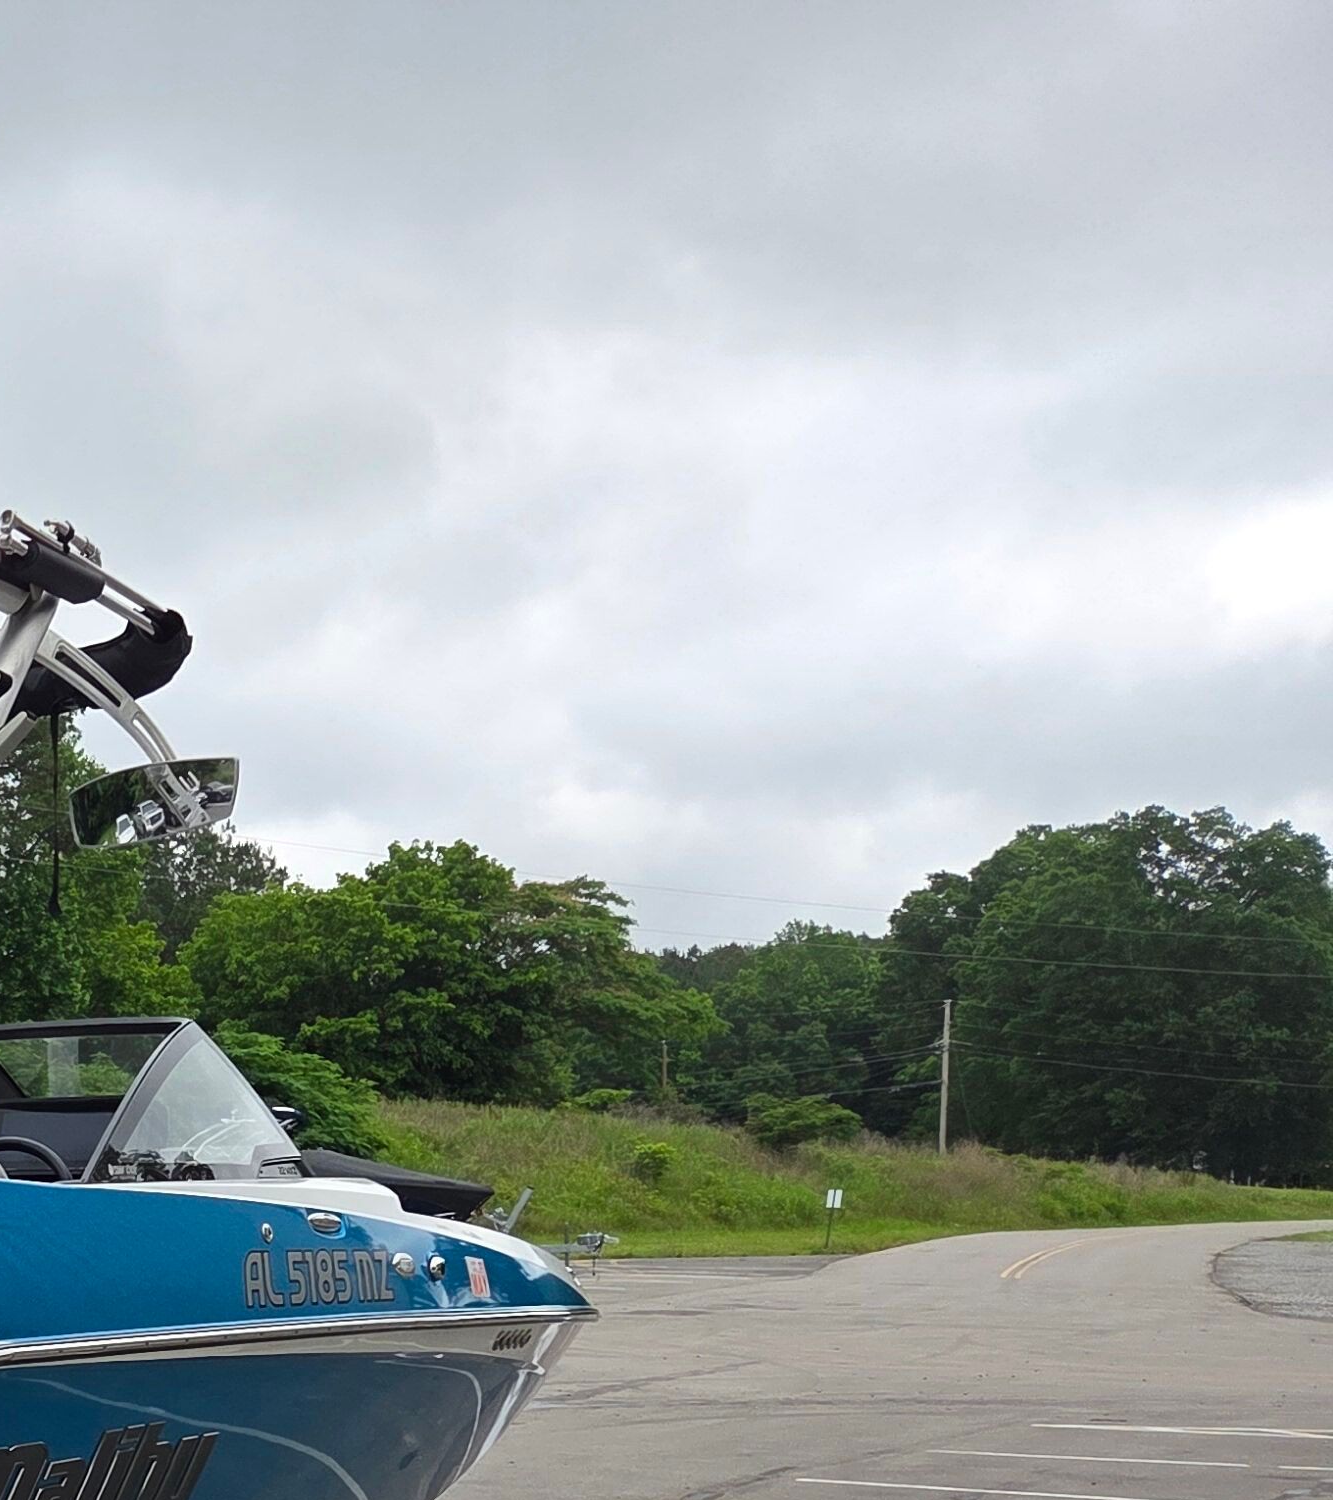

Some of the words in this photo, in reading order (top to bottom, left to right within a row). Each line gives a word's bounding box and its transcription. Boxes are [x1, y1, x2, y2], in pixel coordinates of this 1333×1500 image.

[244, 1250, 284, 1307] AL
[287, 1248, 351, 1305] 5185
[353, 1249, 394, 1302] MZ
